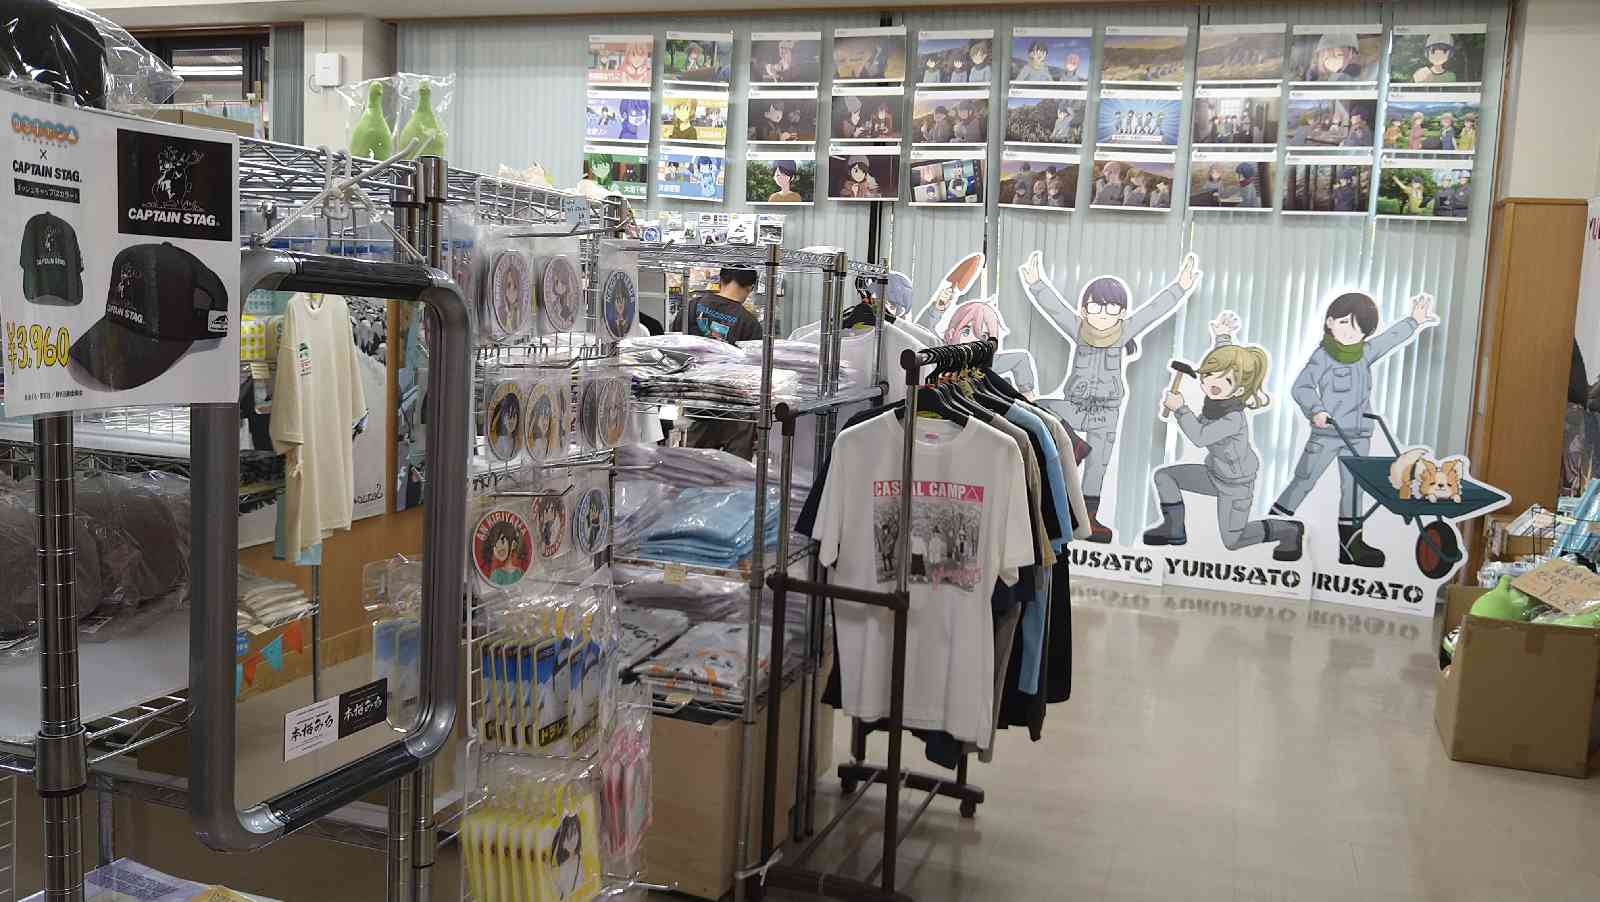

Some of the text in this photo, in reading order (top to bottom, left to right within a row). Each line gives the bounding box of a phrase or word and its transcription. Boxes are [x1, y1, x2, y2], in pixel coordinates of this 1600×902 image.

[12, 160, 53, 178] CAPTAIN
[128, 207, 181, 224] CAPTAIN
[873, 480, 967, 499] CASAL CAMP
[1165, 557, 1301, 588] YURUSATO
